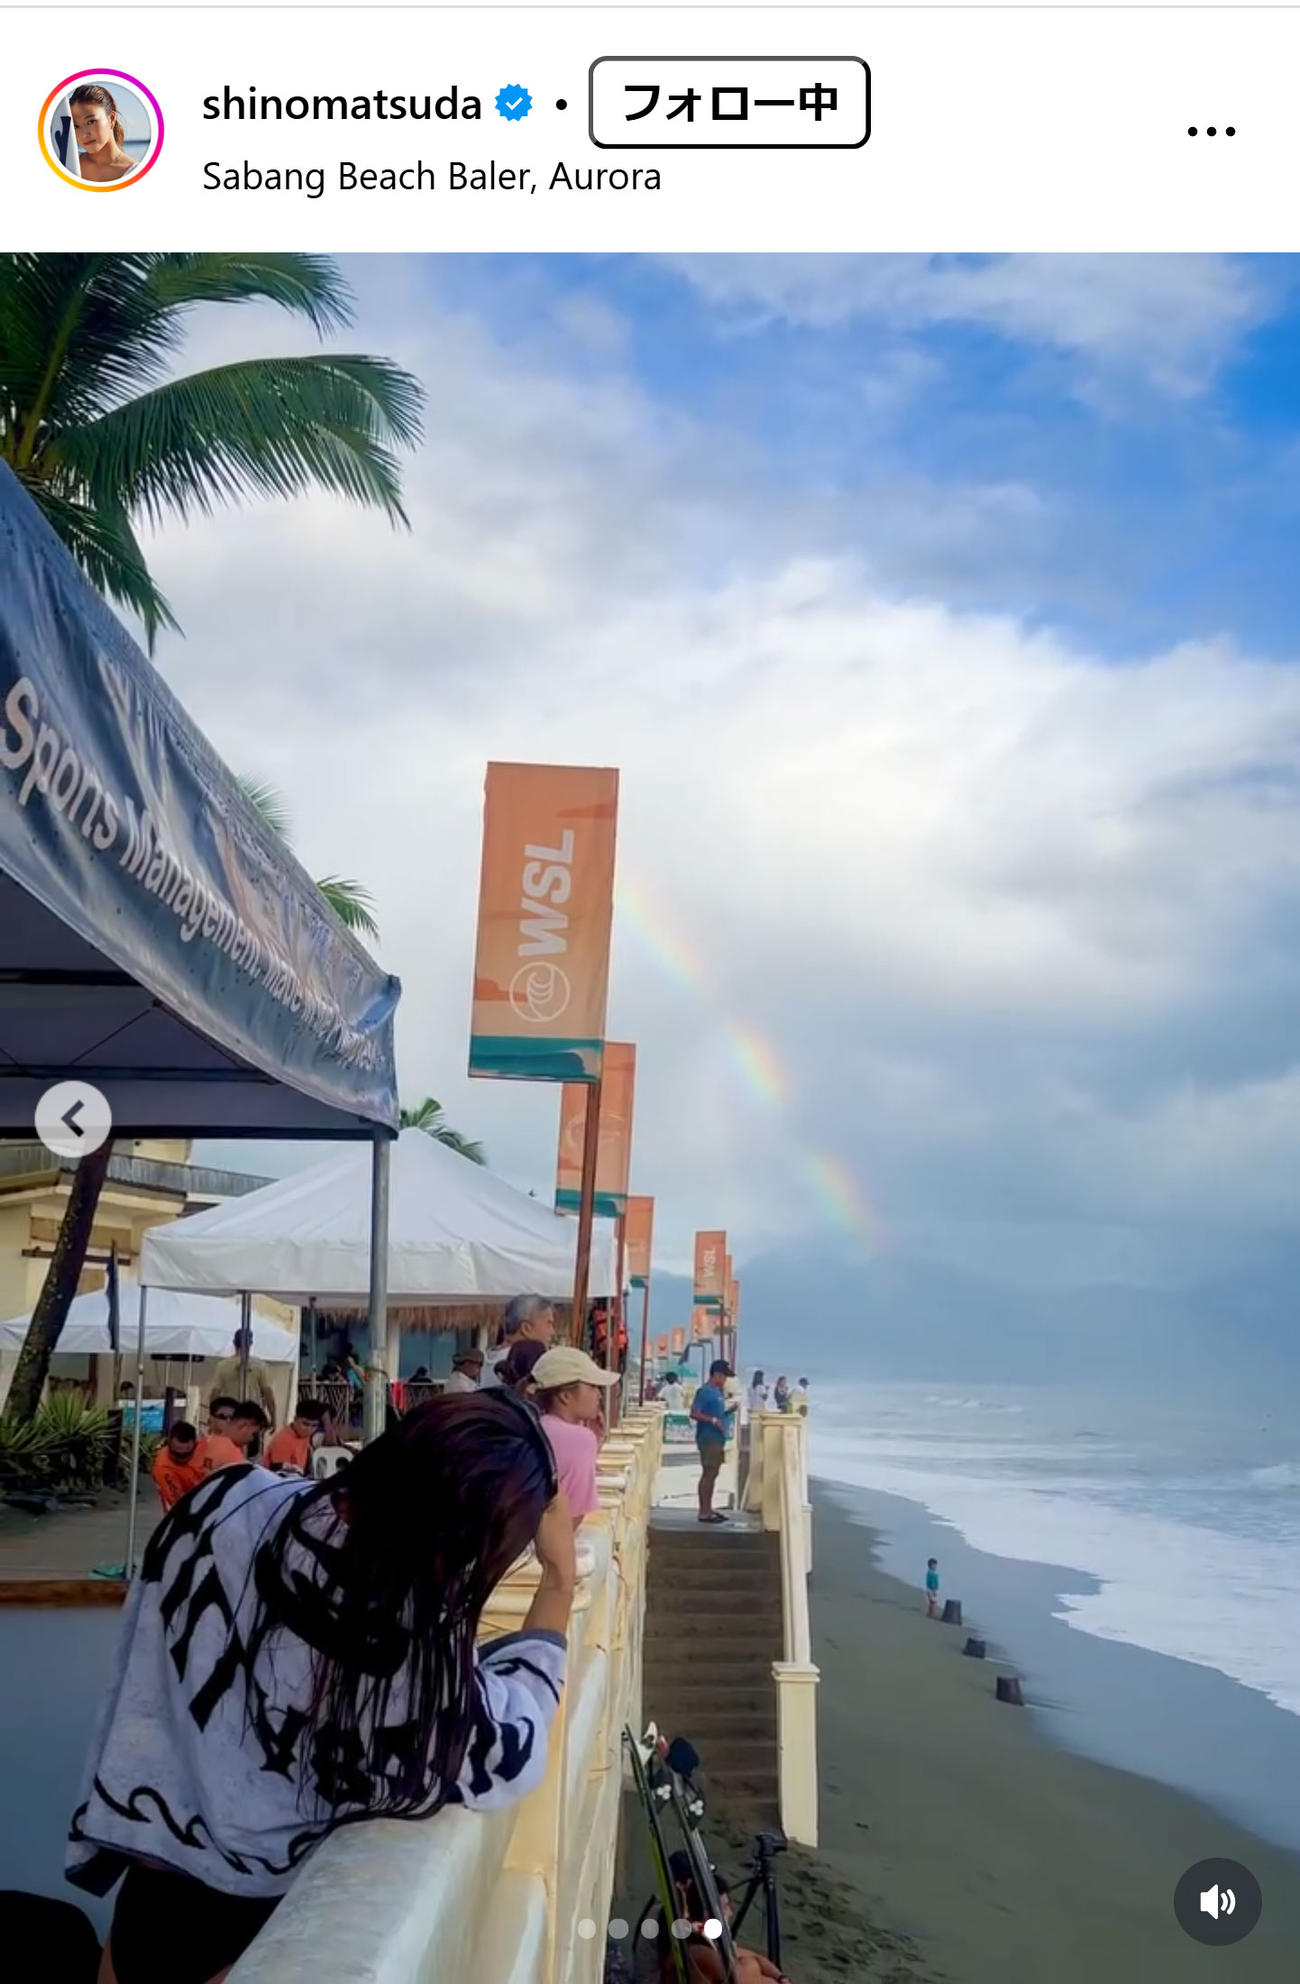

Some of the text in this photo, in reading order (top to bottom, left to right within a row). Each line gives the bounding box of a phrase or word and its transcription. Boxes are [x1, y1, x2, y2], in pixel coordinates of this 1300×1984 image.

[0, 675, 119, 850] Sports
[518, 828, 575, 957] WSL
[702, 1247, 717, 1278] WSL
